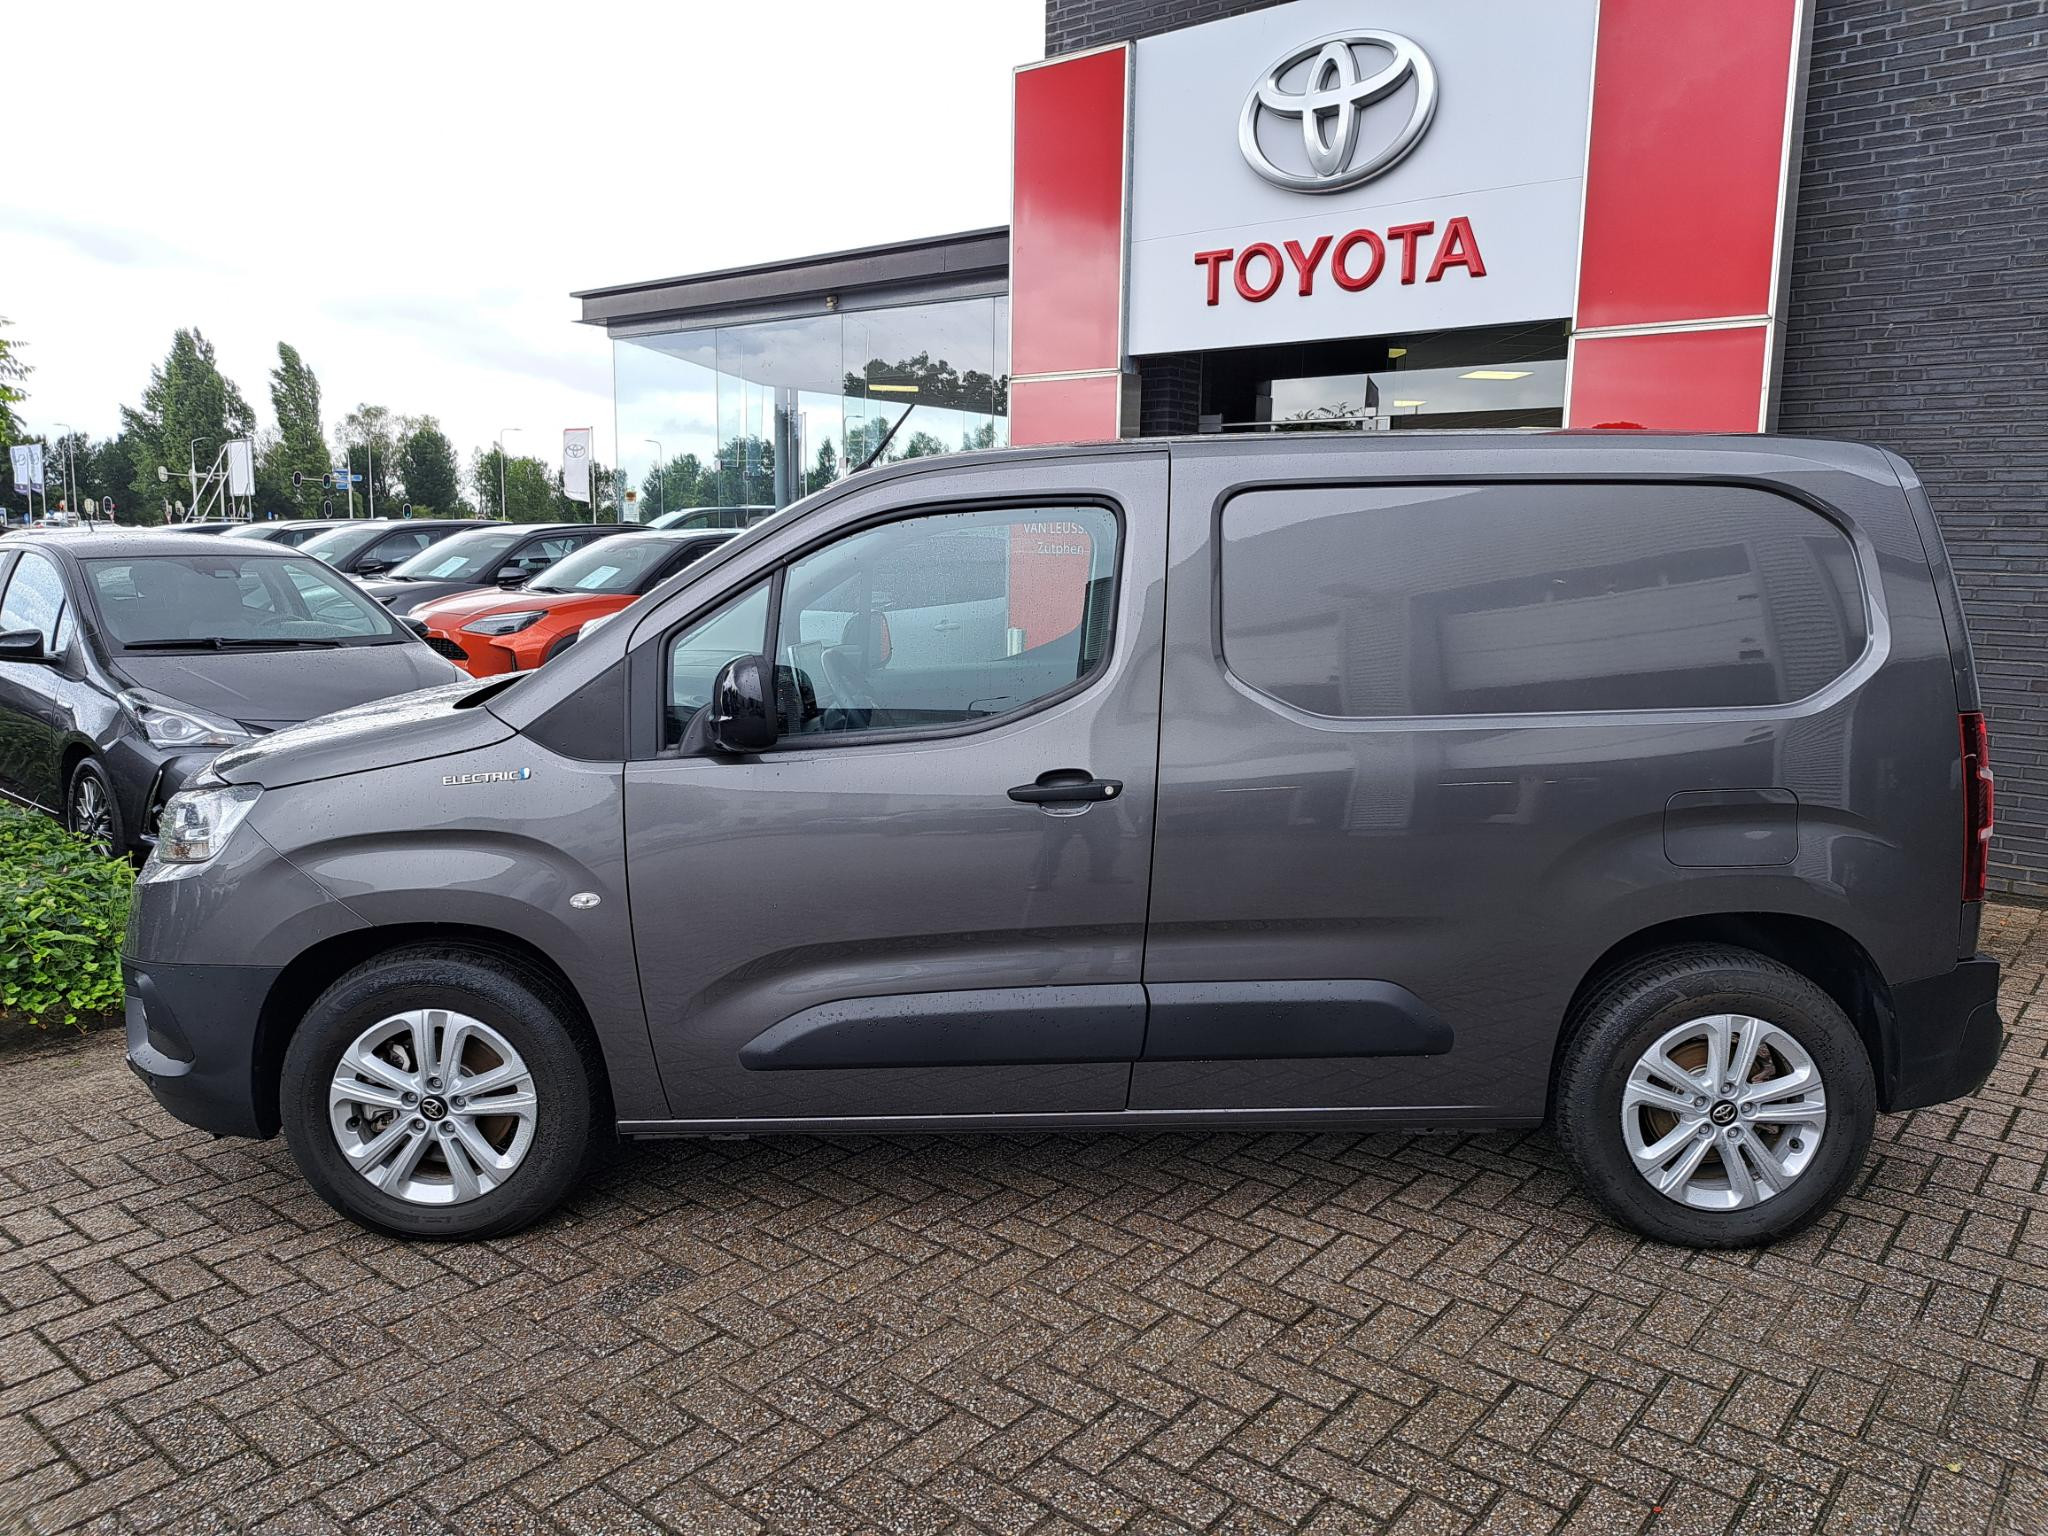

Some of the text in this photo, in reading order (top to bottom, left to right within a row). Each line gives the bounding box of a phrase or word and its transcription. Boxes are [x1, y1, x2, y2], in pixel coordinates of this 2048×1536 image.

[1194, 216, 1487, 306] TOYOTA
[1023, 522, 1088, 535] VAN LEUSS
[1037, 541, 1084, 557] Zutphen
[442, 770, 519, 786] ELECTRIC
